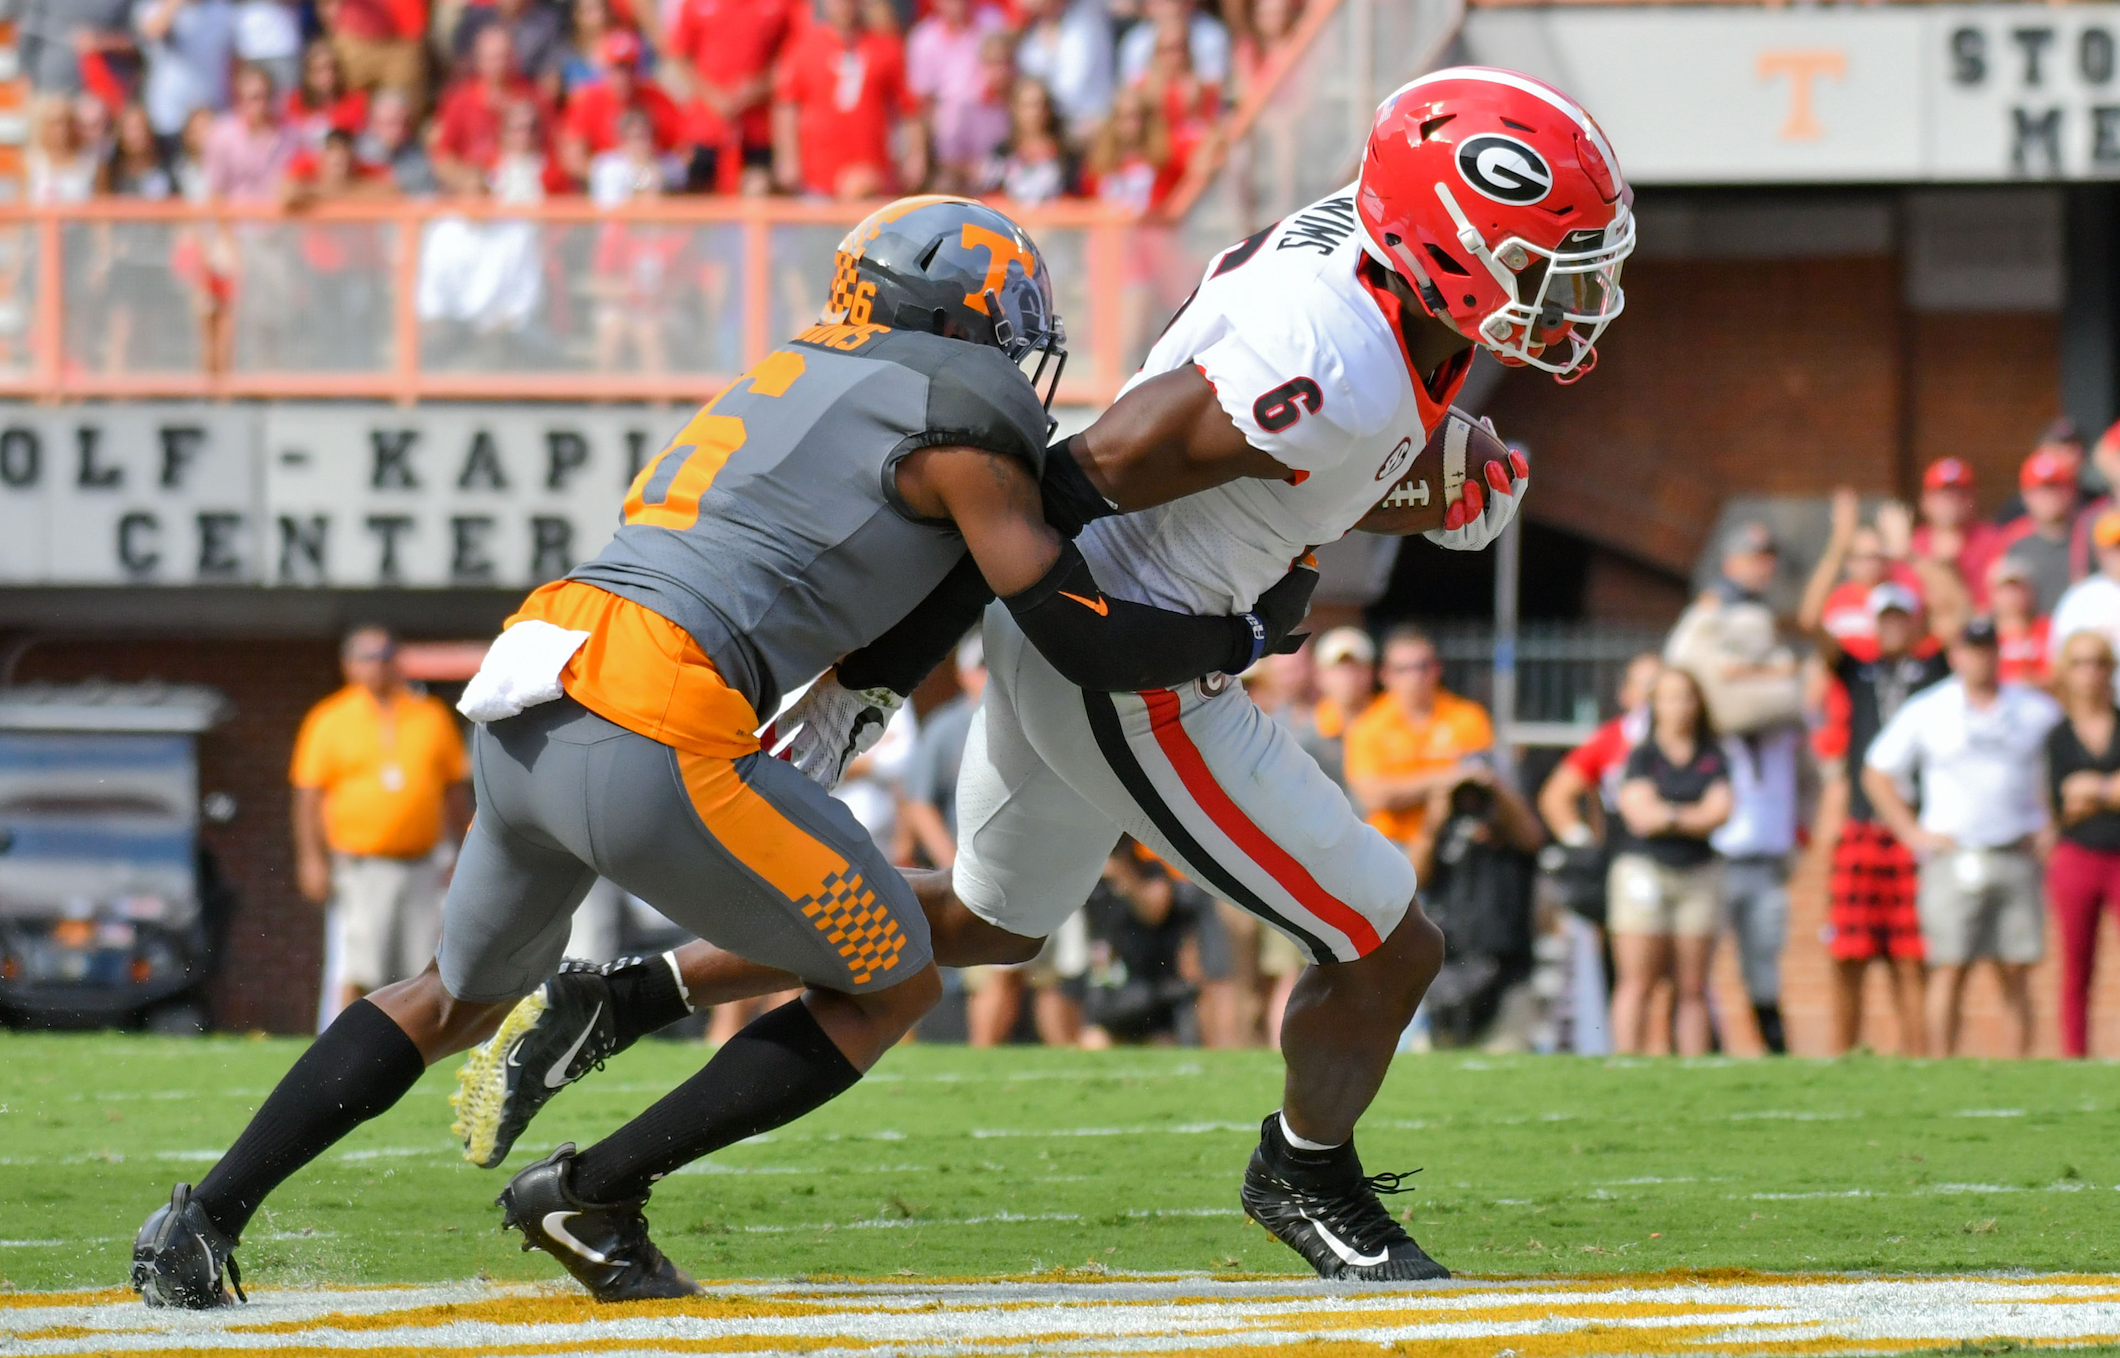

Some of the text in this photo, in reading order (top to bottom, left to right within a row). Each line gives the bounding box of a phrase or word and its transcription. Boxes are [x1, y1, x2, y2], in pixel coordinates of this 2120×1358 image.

[1952, 27, 2114, 85] STO
[1458, 136, 1549, 202] G
[1276, 196, 1356, 257] WIMS
[960, 222, 1035, 318] T
[849, 281, 878, 327] 6
[1253, 376, 1324, 433] 6
[623, 350, 806, 531] 6
[118, 512, 573, 577] CENTER
